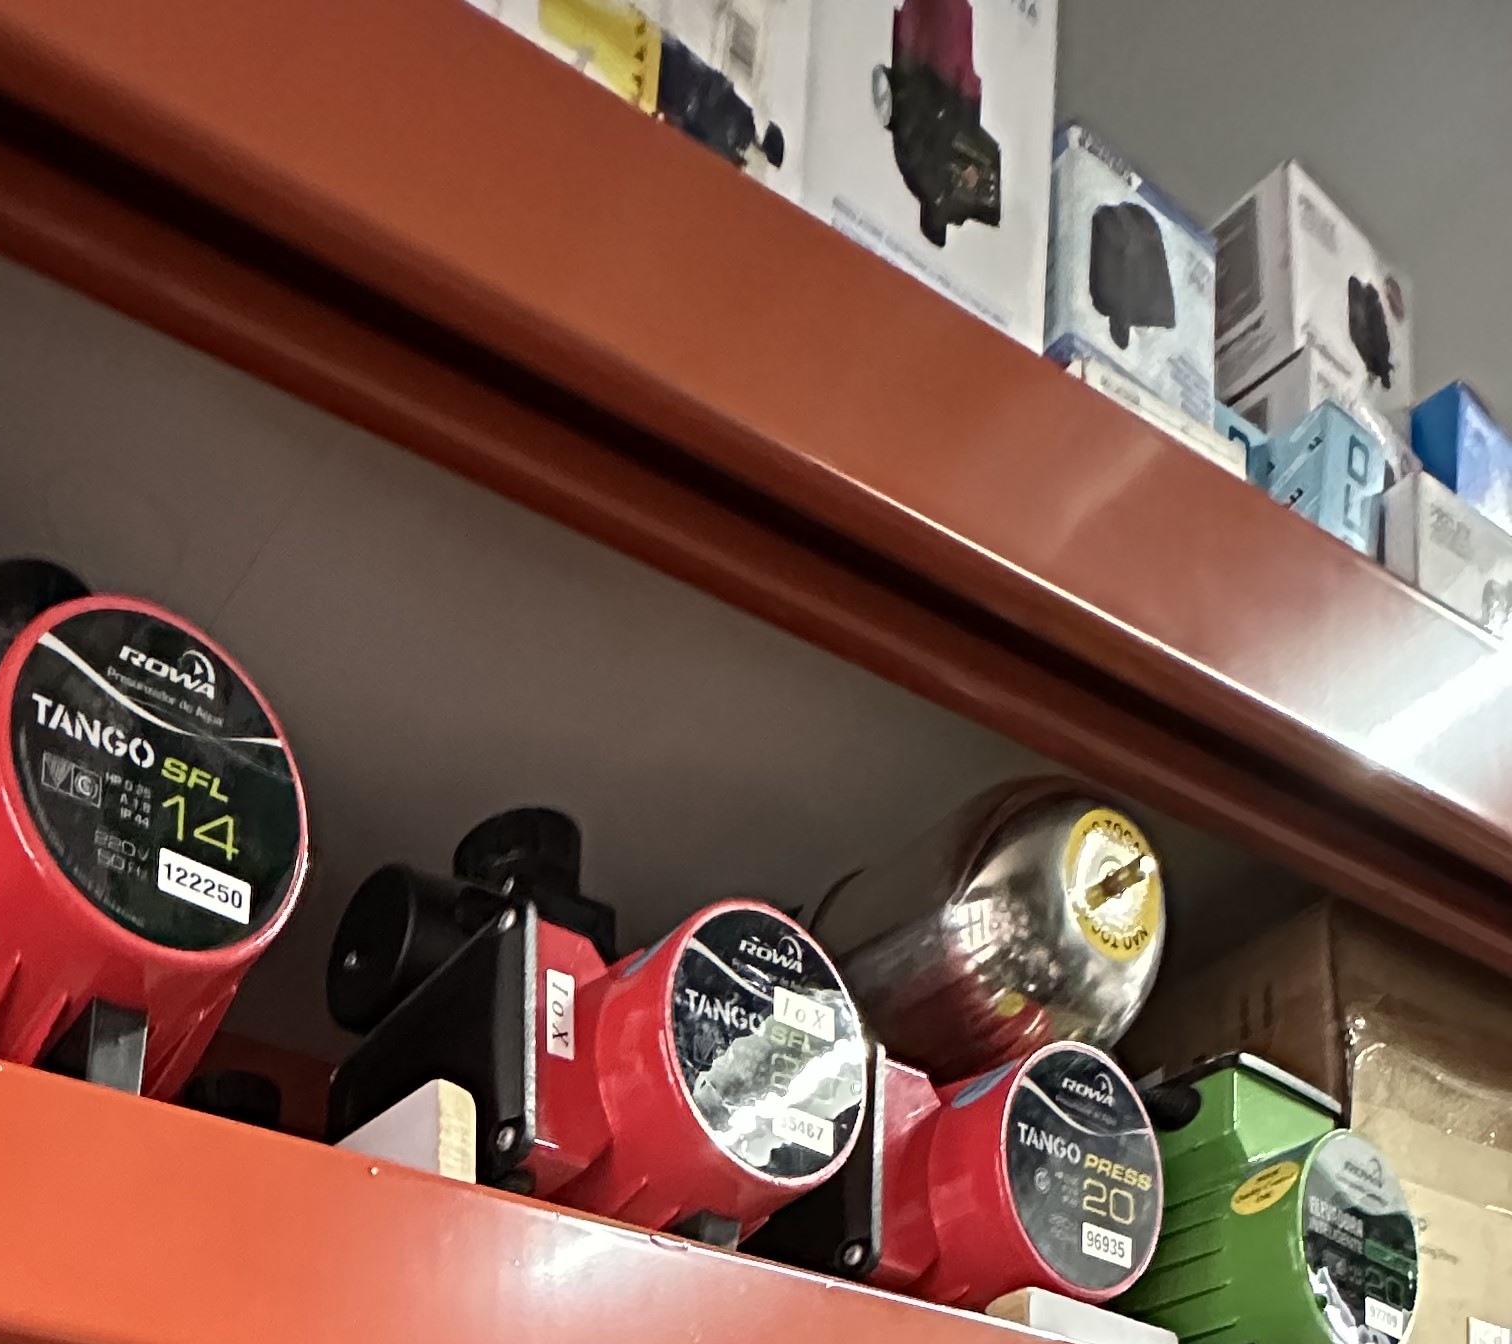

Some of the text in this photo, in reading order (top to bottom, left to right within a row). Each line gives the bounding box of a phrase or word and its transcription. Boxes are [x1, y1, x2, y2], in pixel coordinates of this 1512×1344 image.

[118, 645, 216, 700] ROWA
[31, 692, 156, 769] TANGO
[160, 756, 229, 804] SFL
[161, 795, 240, 862] 14
[162, 862, 244, 910] 122250
[738, 938, 803, 974] ROWA
[685, 988, 765, 1035] TANGO
[1061, 1076, 1116, 1107] ROWA
[1017, 1121, 1081, 1165] TANGO
[1083, 1152, 1153, 1192] PRESS
[1082, 1177, 1136, 1226] 20
[1086, 1229, 1125, 1259] 96935
